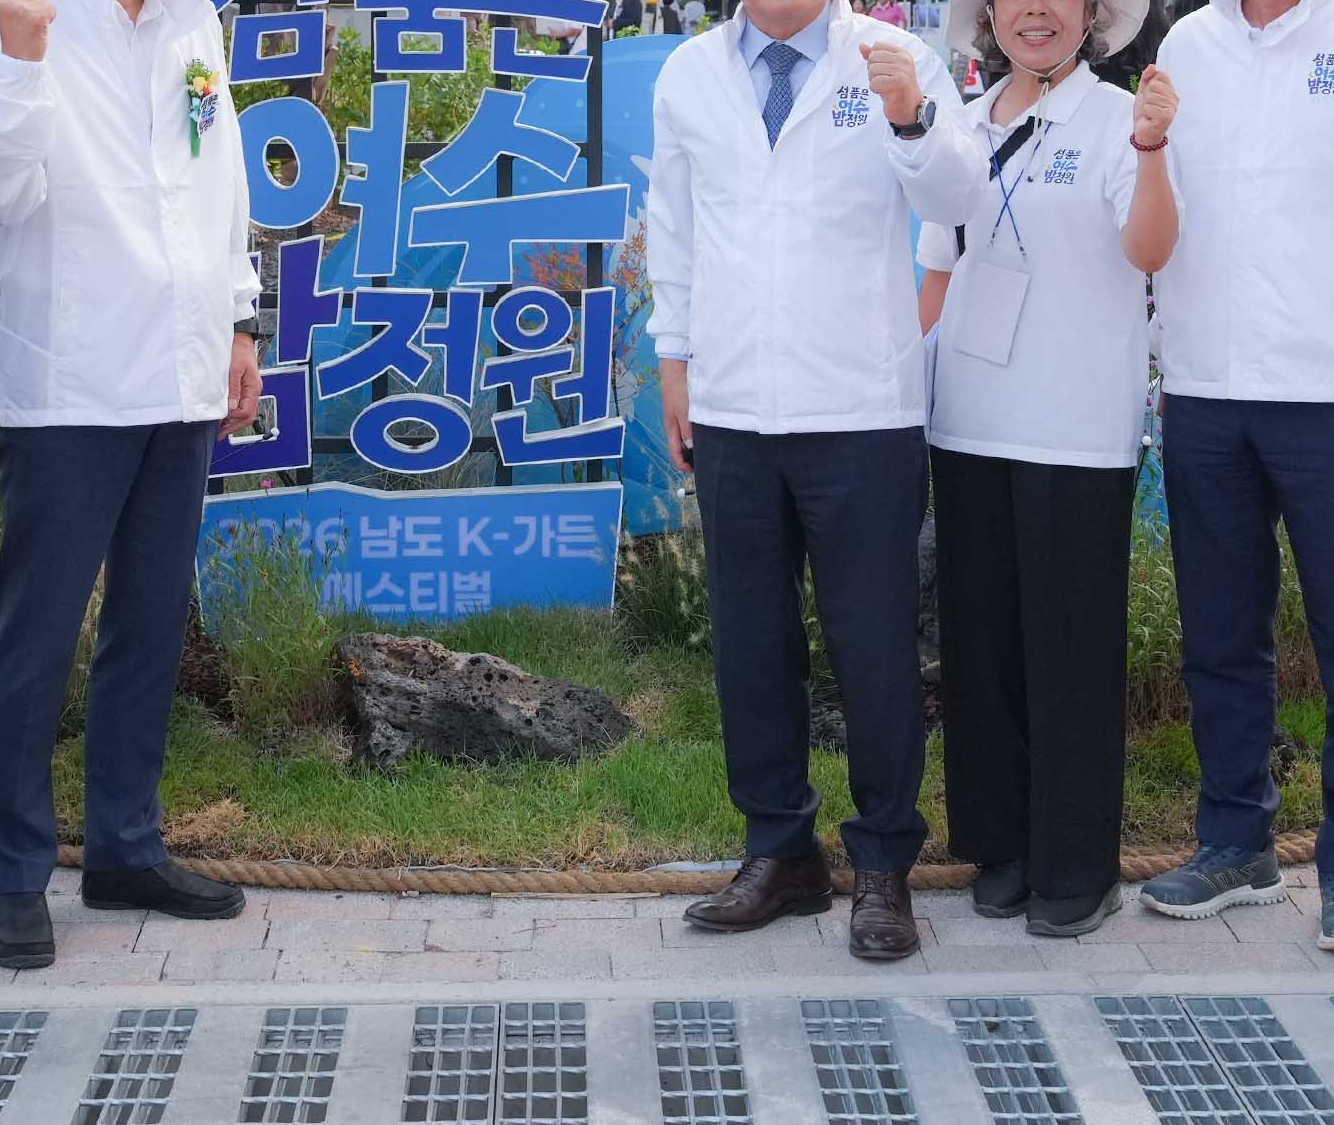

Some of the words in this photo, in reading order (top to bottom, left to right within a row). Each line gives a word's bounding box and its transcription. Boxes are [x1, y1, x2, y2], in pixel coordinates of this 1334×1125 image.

[241, 81, 632, 287] 여수
[359, 515, 444, 559] 남도
[458, 514, 598, 560] K-가든
